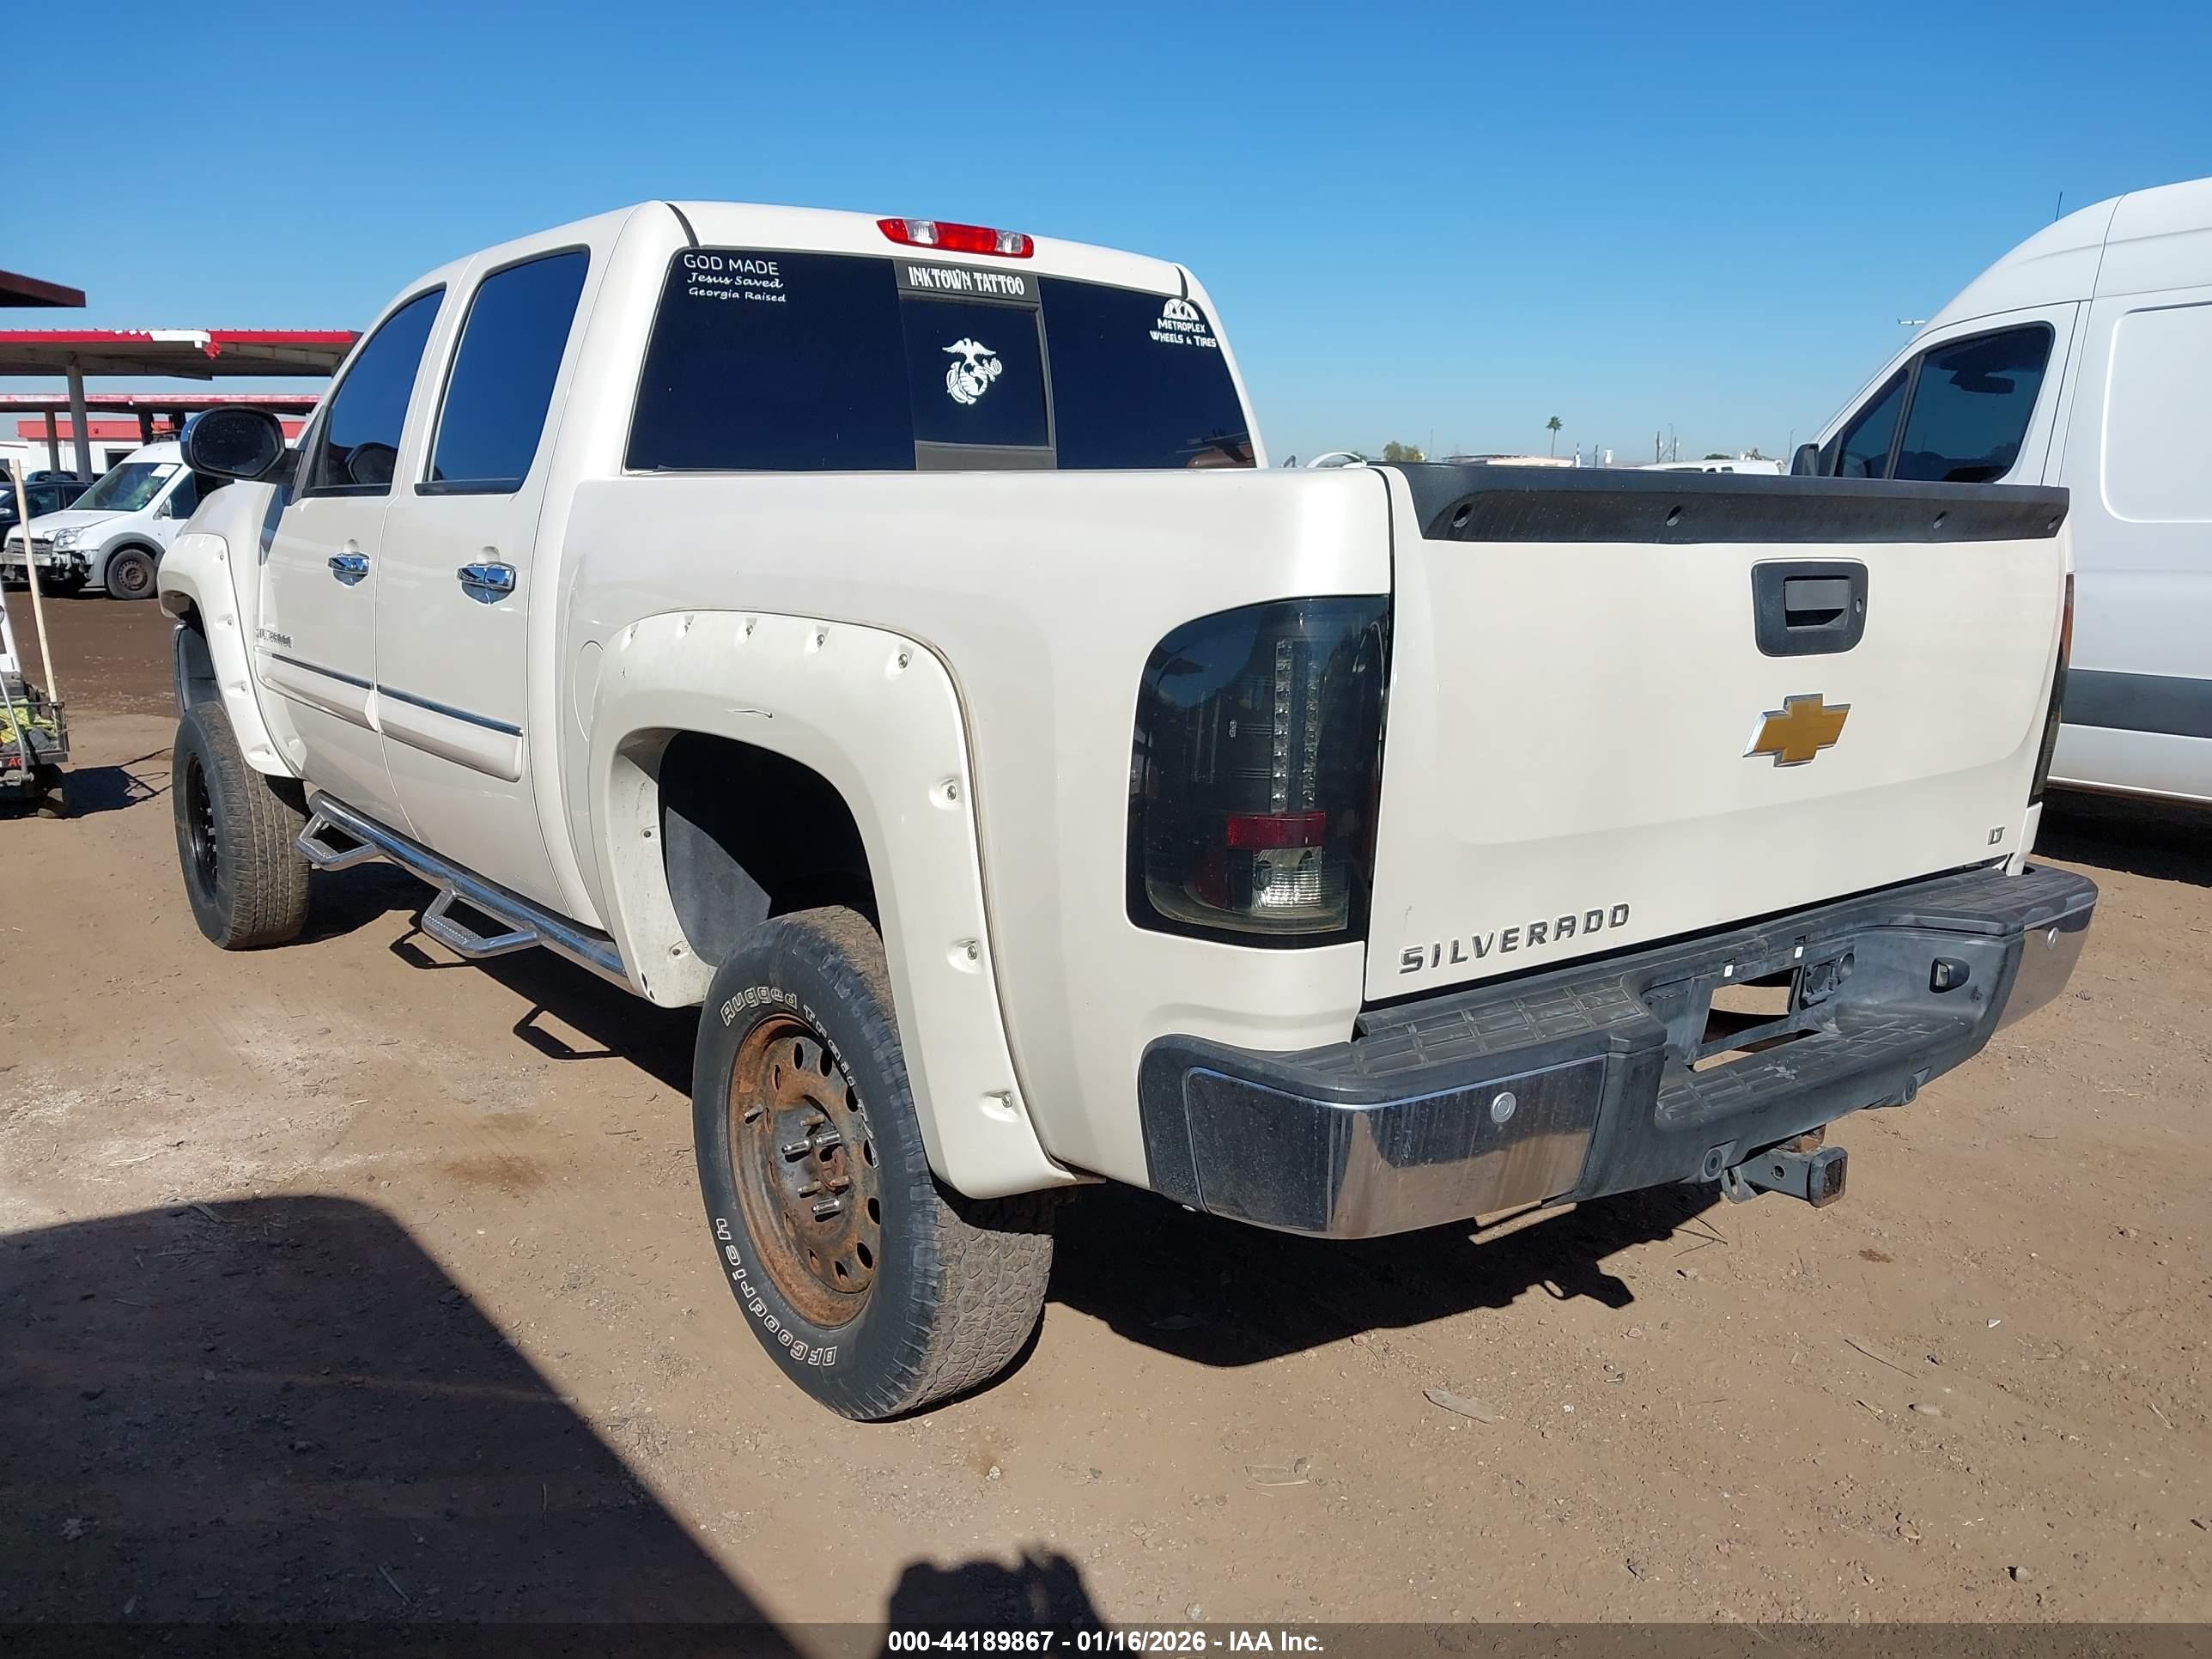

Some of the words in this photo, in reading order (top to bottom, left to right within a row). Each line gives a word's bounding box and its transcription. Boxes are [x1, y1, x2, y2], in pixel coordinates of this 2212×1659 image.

[684, 254, 723, 270] GOD
[729, 258, 780, 275] MADE
[687, 271, 732, 285] Jesus
[734, 275, 784, 289] Saved
[908, 266, 973, 290] INKTOWN
[973, 271, 1025, 295] TATTOO
[689, 287, 740, 300] Georgia
[744, 290, 787, 302] Raised
[1157, 317, 1206, 333] METROPLEX
[1149, 330, 1184, 344] WHEELS
[1193, 335, 1217, 348] TIRES
[1398, 902, 1630, 975] SILVERADO
[720, 986, 798, 1027] Rugged
[715, 1218, 838, 1366] BFGoodrich
